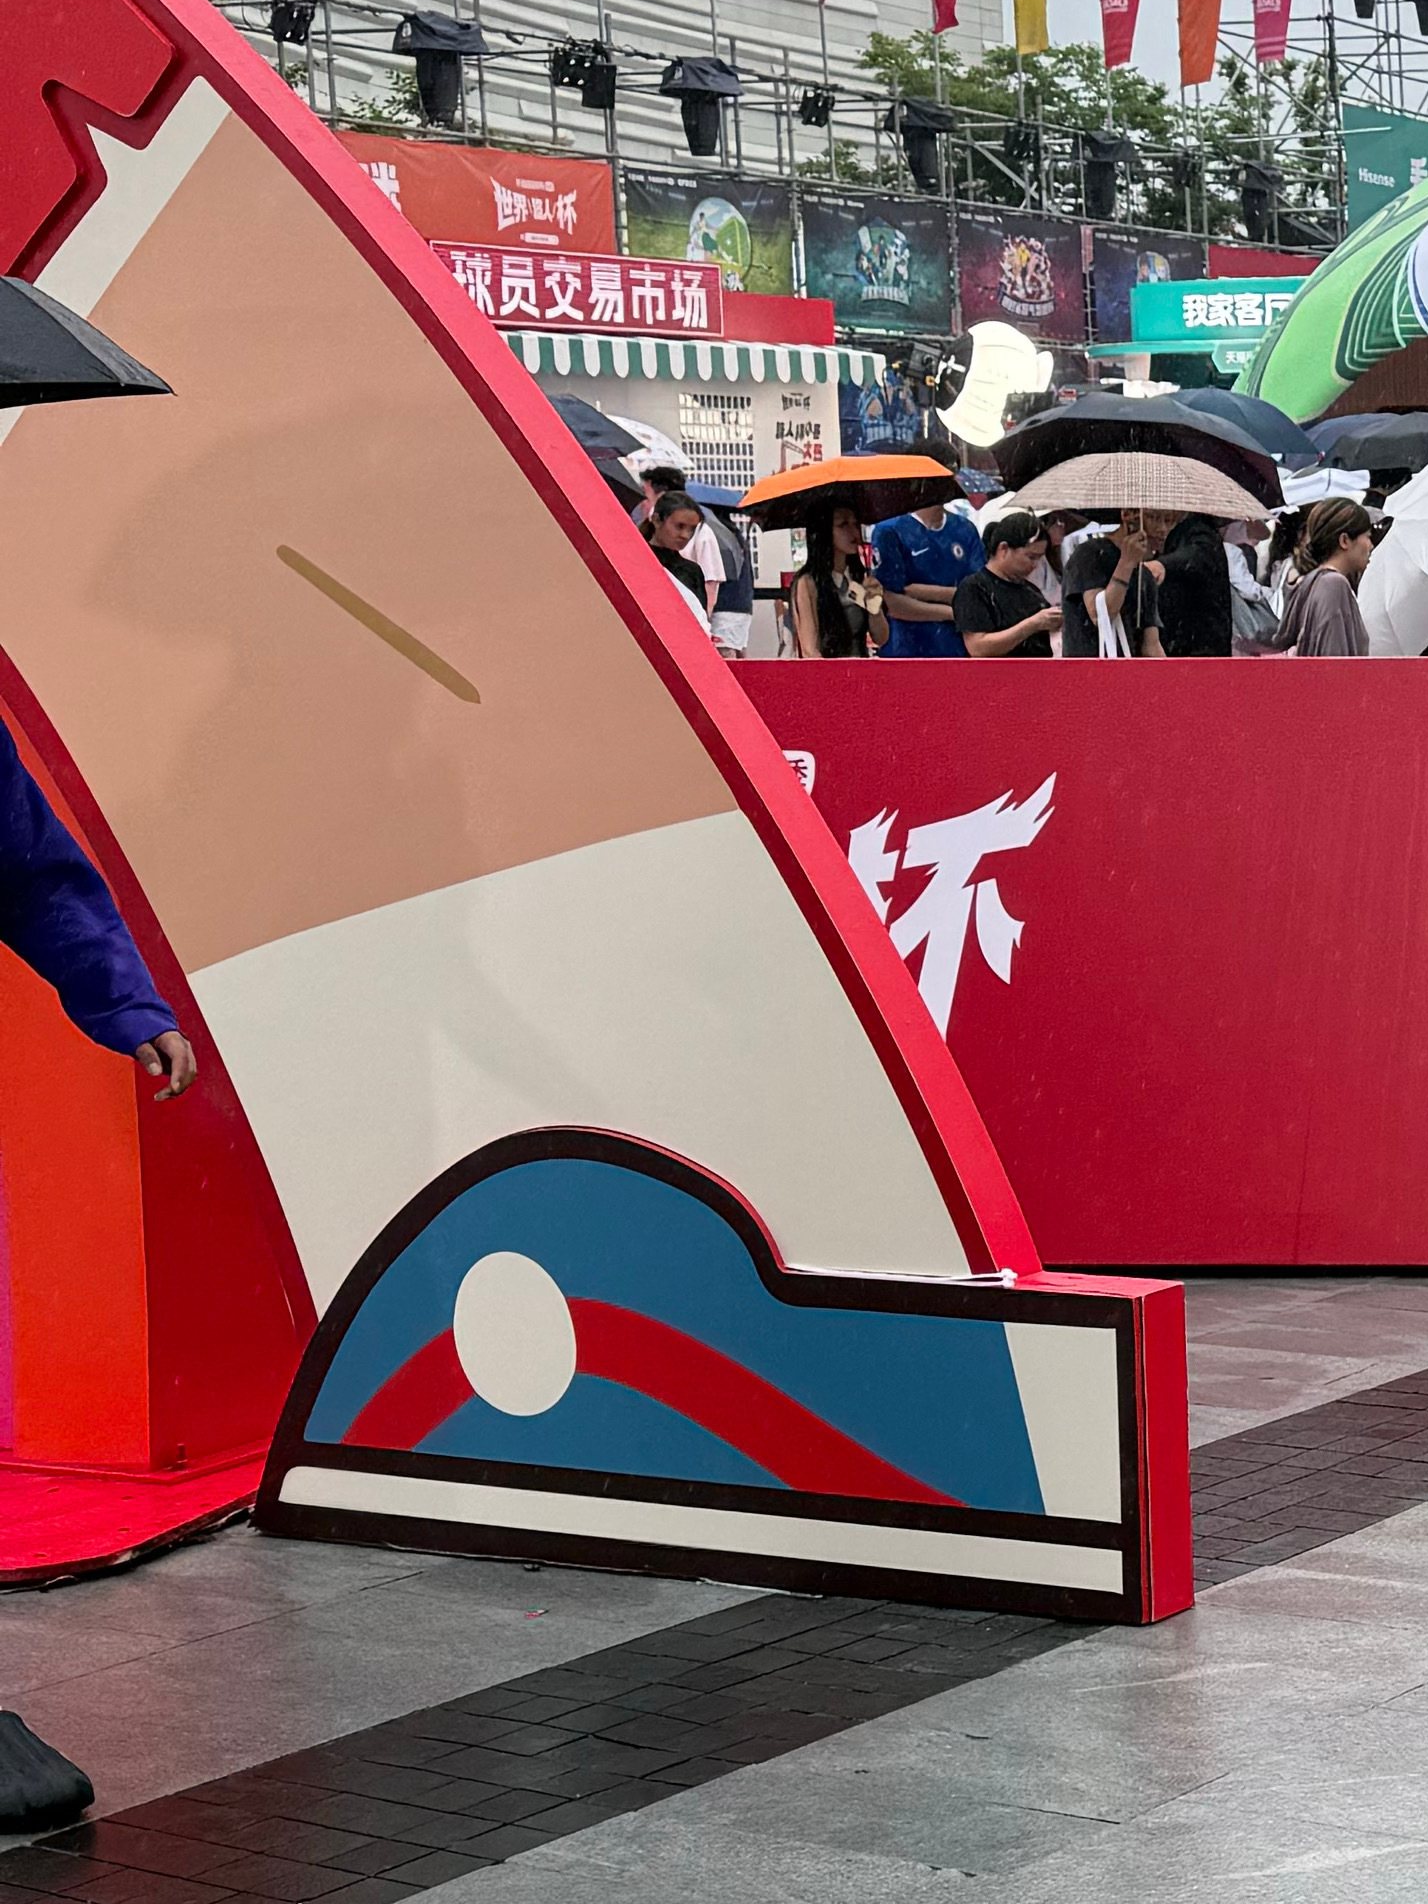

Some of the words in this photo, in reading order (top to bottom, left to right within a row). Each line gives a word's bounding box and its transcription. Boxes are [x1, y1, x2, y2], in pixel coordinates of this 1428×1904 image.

[1358, 167, 1395, 188] Hisense
[450, 250, 708, 328] 球员交易市场
